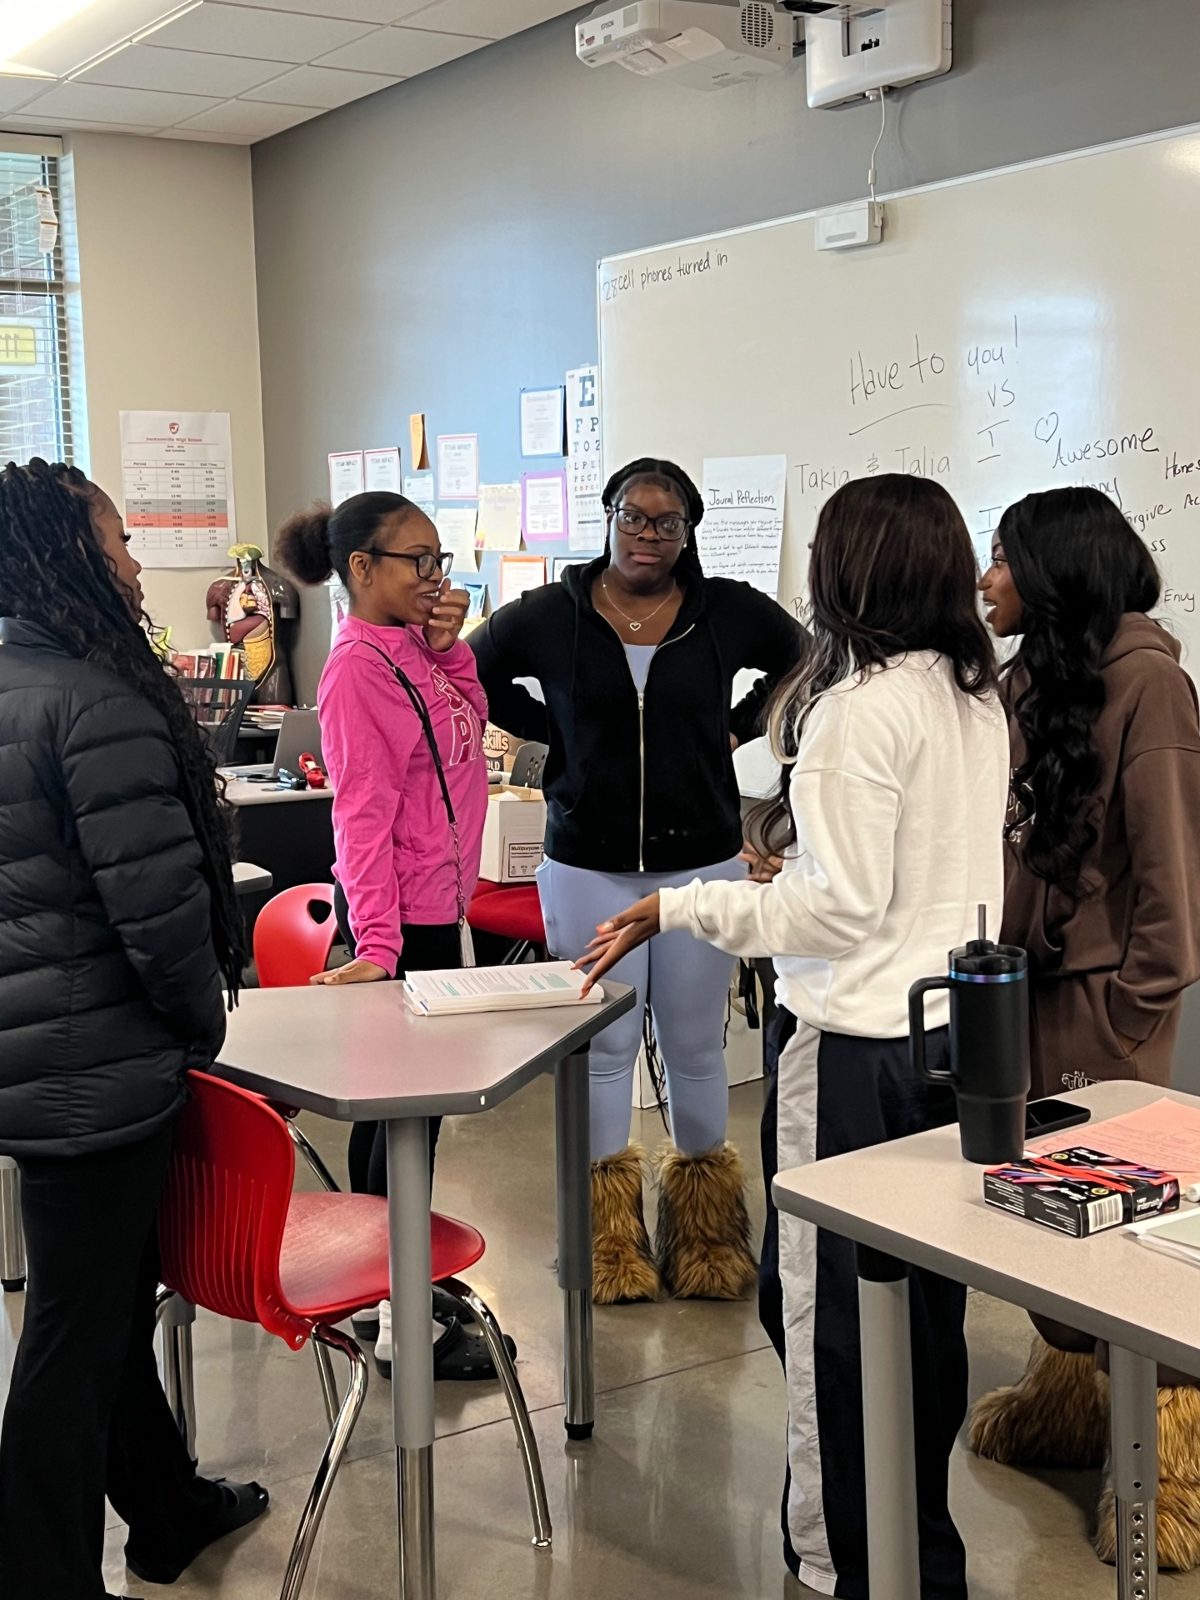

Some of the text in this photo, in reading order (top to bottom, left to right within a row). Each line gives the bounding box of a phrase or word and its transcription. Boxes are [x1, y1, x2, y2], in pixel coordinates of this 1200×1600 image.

[641, 266, 672, 290] phones
[677, 251, 710, 277] turned
[715, 249, 728, 266] in
[850, 351, 904, 405] Have
[909, 334, 944, 383] to
[579, 375, 595, 407] E
[590, 417, 599, 432] P
[1053, 428, 1159, 468] Awesome
[795, 463, 850, 494] Takia
[1164, 589, 1195, 612] Envy
